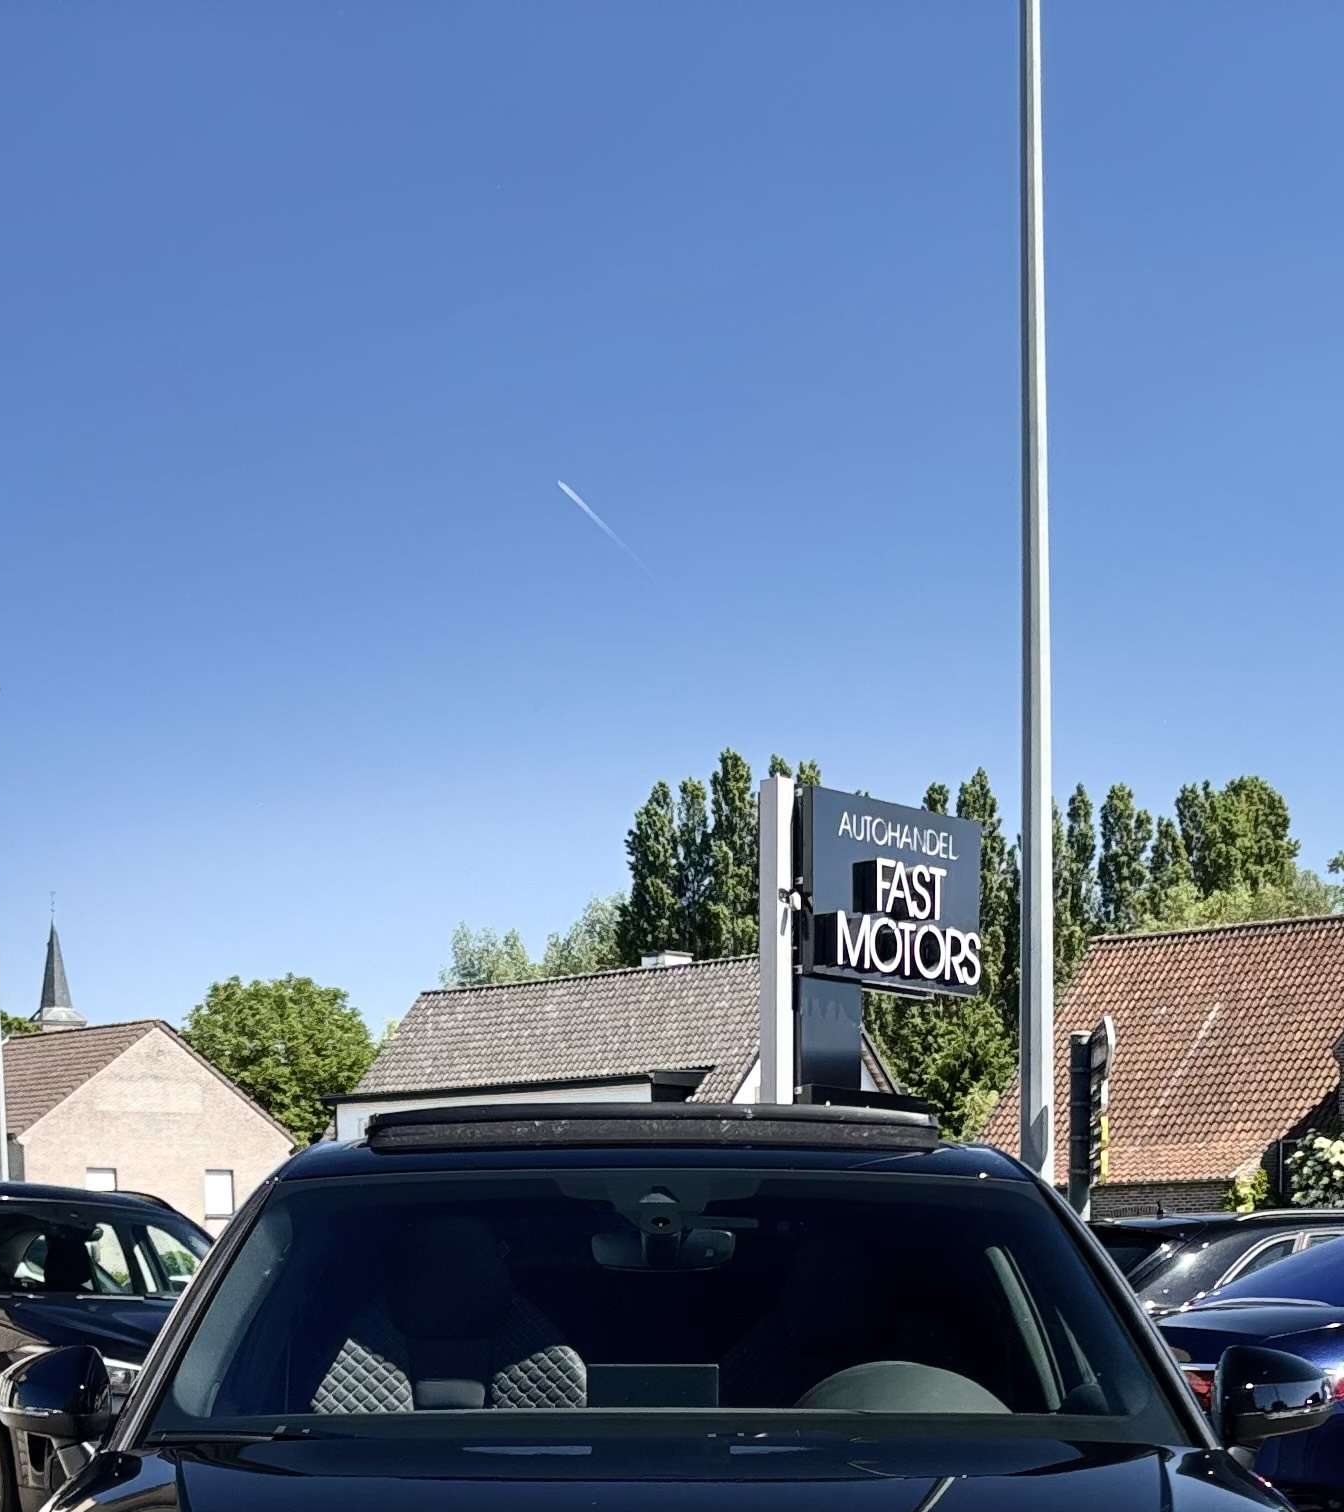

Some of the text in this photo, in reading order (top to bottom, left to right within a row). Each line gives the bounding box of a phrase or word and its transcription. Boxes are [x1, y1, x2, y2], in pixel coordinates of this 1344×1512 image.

[838, 811, 960, 860] AUTOHANDEL
[876, 857, 948, 921] FAST
[836, 910, 982, 986] MOTORS
